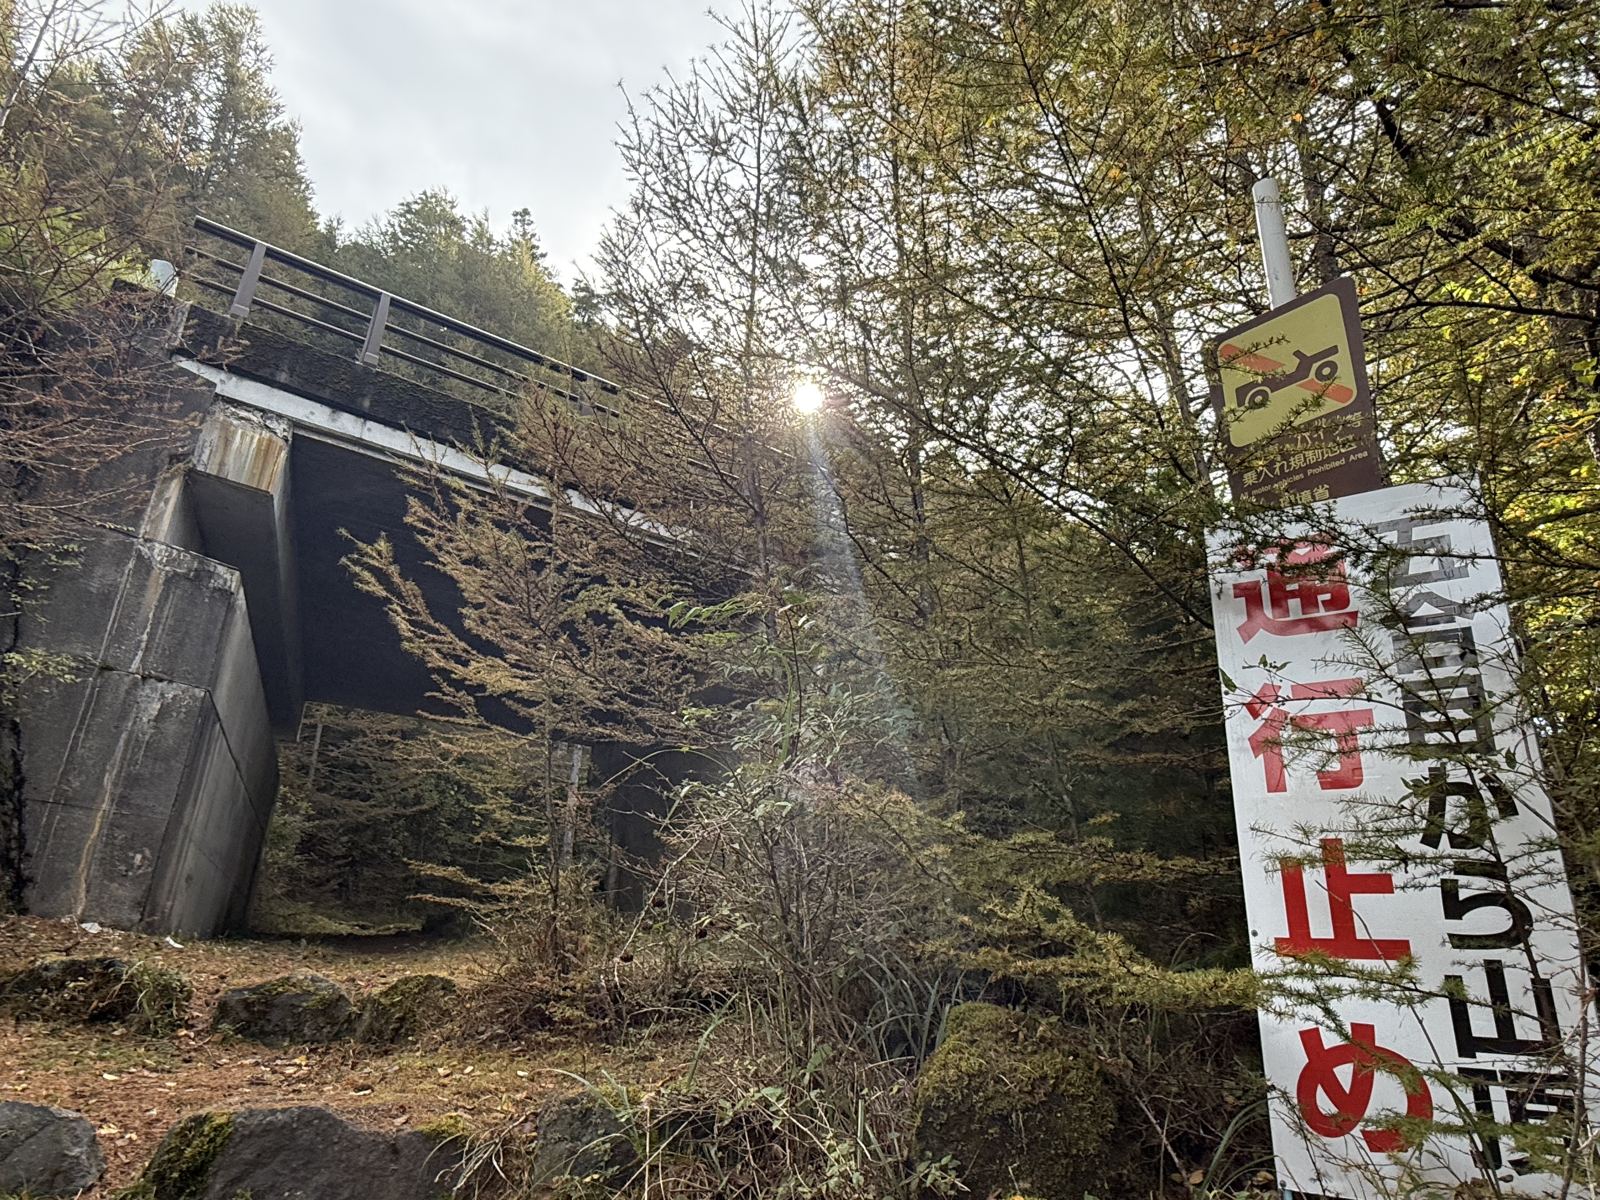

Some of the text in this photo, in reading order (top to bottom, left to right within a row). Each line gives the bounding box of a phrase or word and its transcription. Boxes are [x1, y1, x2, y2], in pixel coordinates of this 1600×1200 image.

[1251, 485, 1271, 496] motor
[1307, 457, 1345, 476] Prohibited
[1349, 450, 1368, 462] Area
[1233, 533, 1433, 1153] 通行止め
